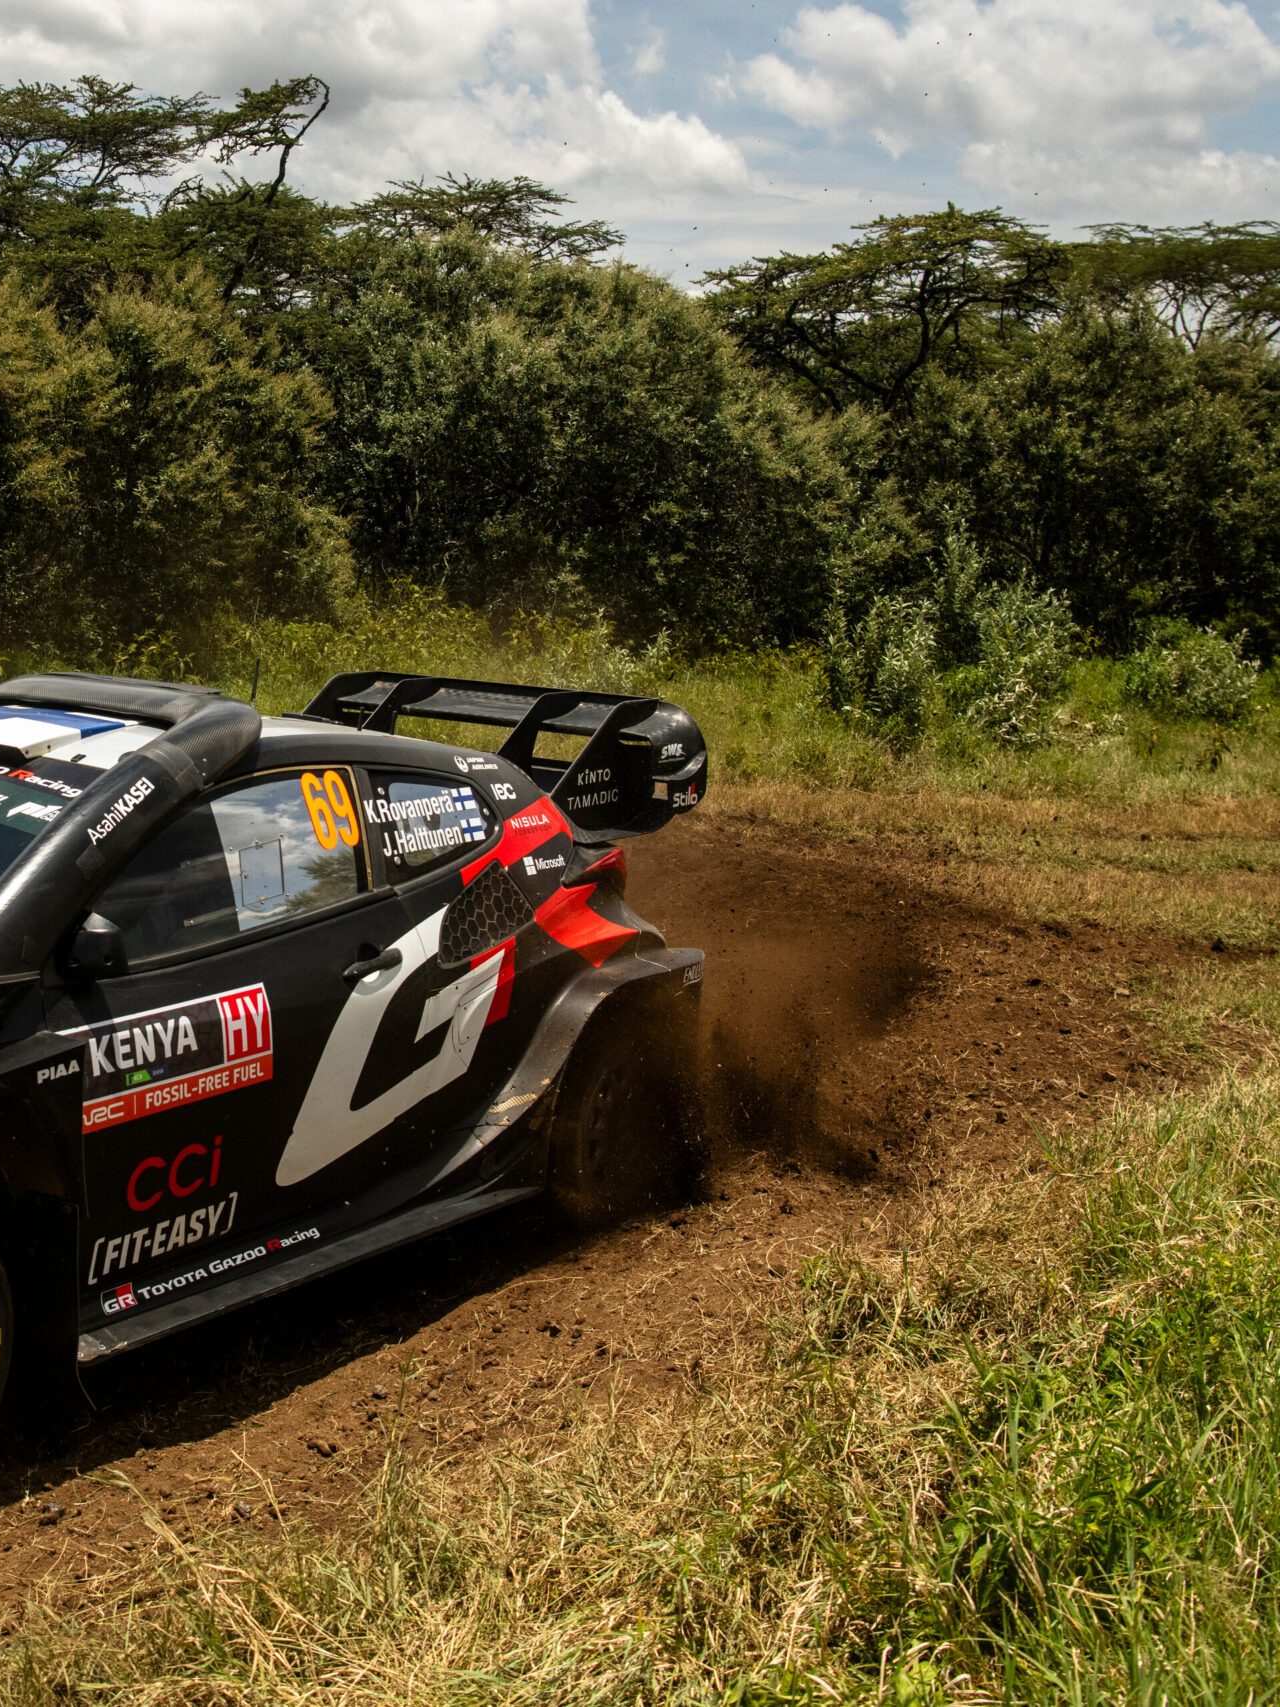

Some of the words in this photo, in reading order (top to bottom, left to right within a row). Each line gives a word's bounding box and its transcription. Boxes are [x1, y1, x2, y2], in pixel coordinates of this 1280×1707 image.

[660, 743, 684, 760] SWS
[8, 769, 83, 798] Racing
[672, 785, 698, 808] Stilo
[87, 776, 156, 845] AsahiKASEI
[301, 770, 360, 850] 69
[567, 788, 619, 811] TAMADIC
[510, 814, 549, 829] NISULA
[535, 854, 566, 870] Microsoft
[88, 1015, 198, 1077] KENYA
[222, 993, 265, 1056] HY
[36, 1059, 81, 1084] PIAA
[145, 1070, 230, 1110] FOSSIL-FREE
[233, 1062, 264, 1084] FUEL
[103, 1292, 137, 1315] GR
[137, 1269, 208, 1300] TOYOTA
[208, 1246, 267, 1274] GAZOO
[265, 1227, 320, 1253] Racing
